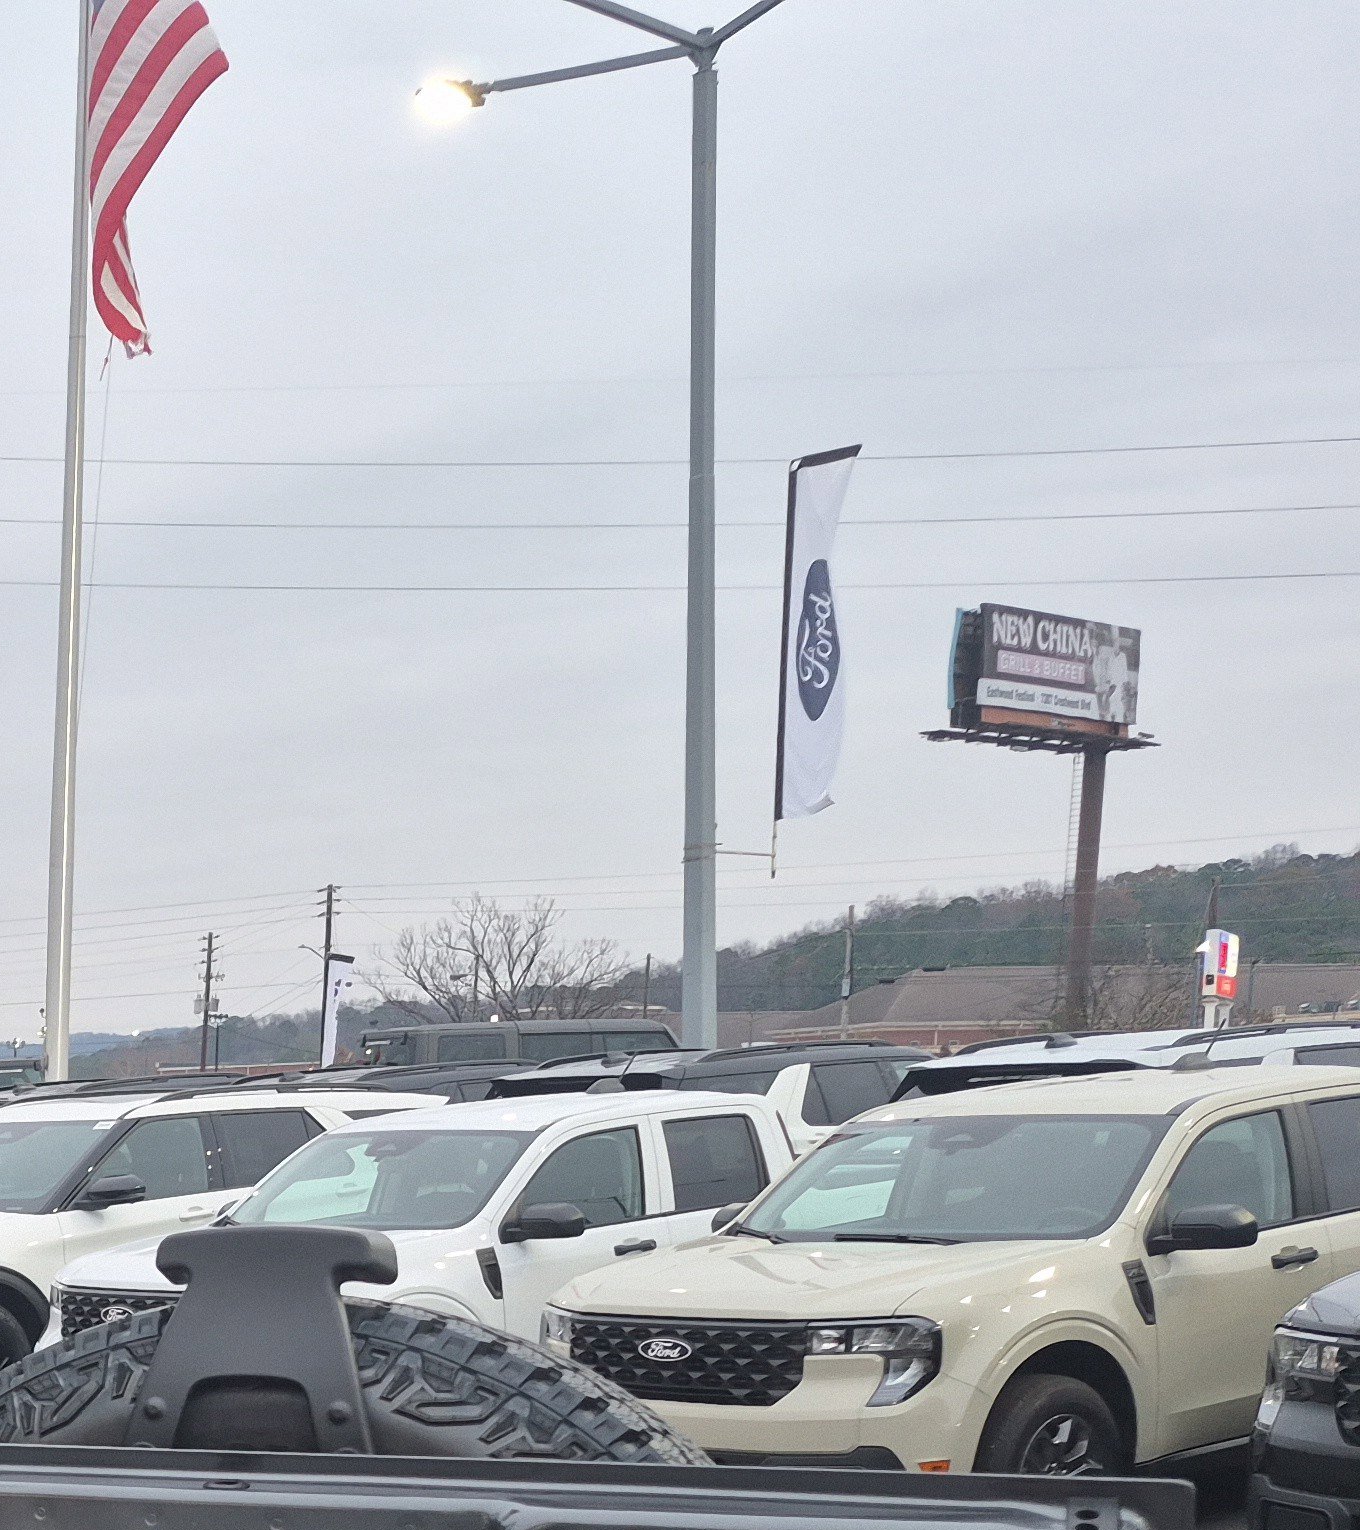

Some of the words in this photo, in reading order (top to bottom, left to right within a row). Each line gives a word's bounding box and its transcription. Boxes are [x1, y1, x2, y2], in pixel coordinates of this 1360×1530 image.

[799, 591, 832, 690] Ford
[992, 611, 1035, 650] NEW
[1037, 619, 1097, 658] CHINA
[1000, 653, 1030, 673] GRILL
[1044, 661, 1084, 681] BUFFET
[648, 1341, 681, 1358] Ford
